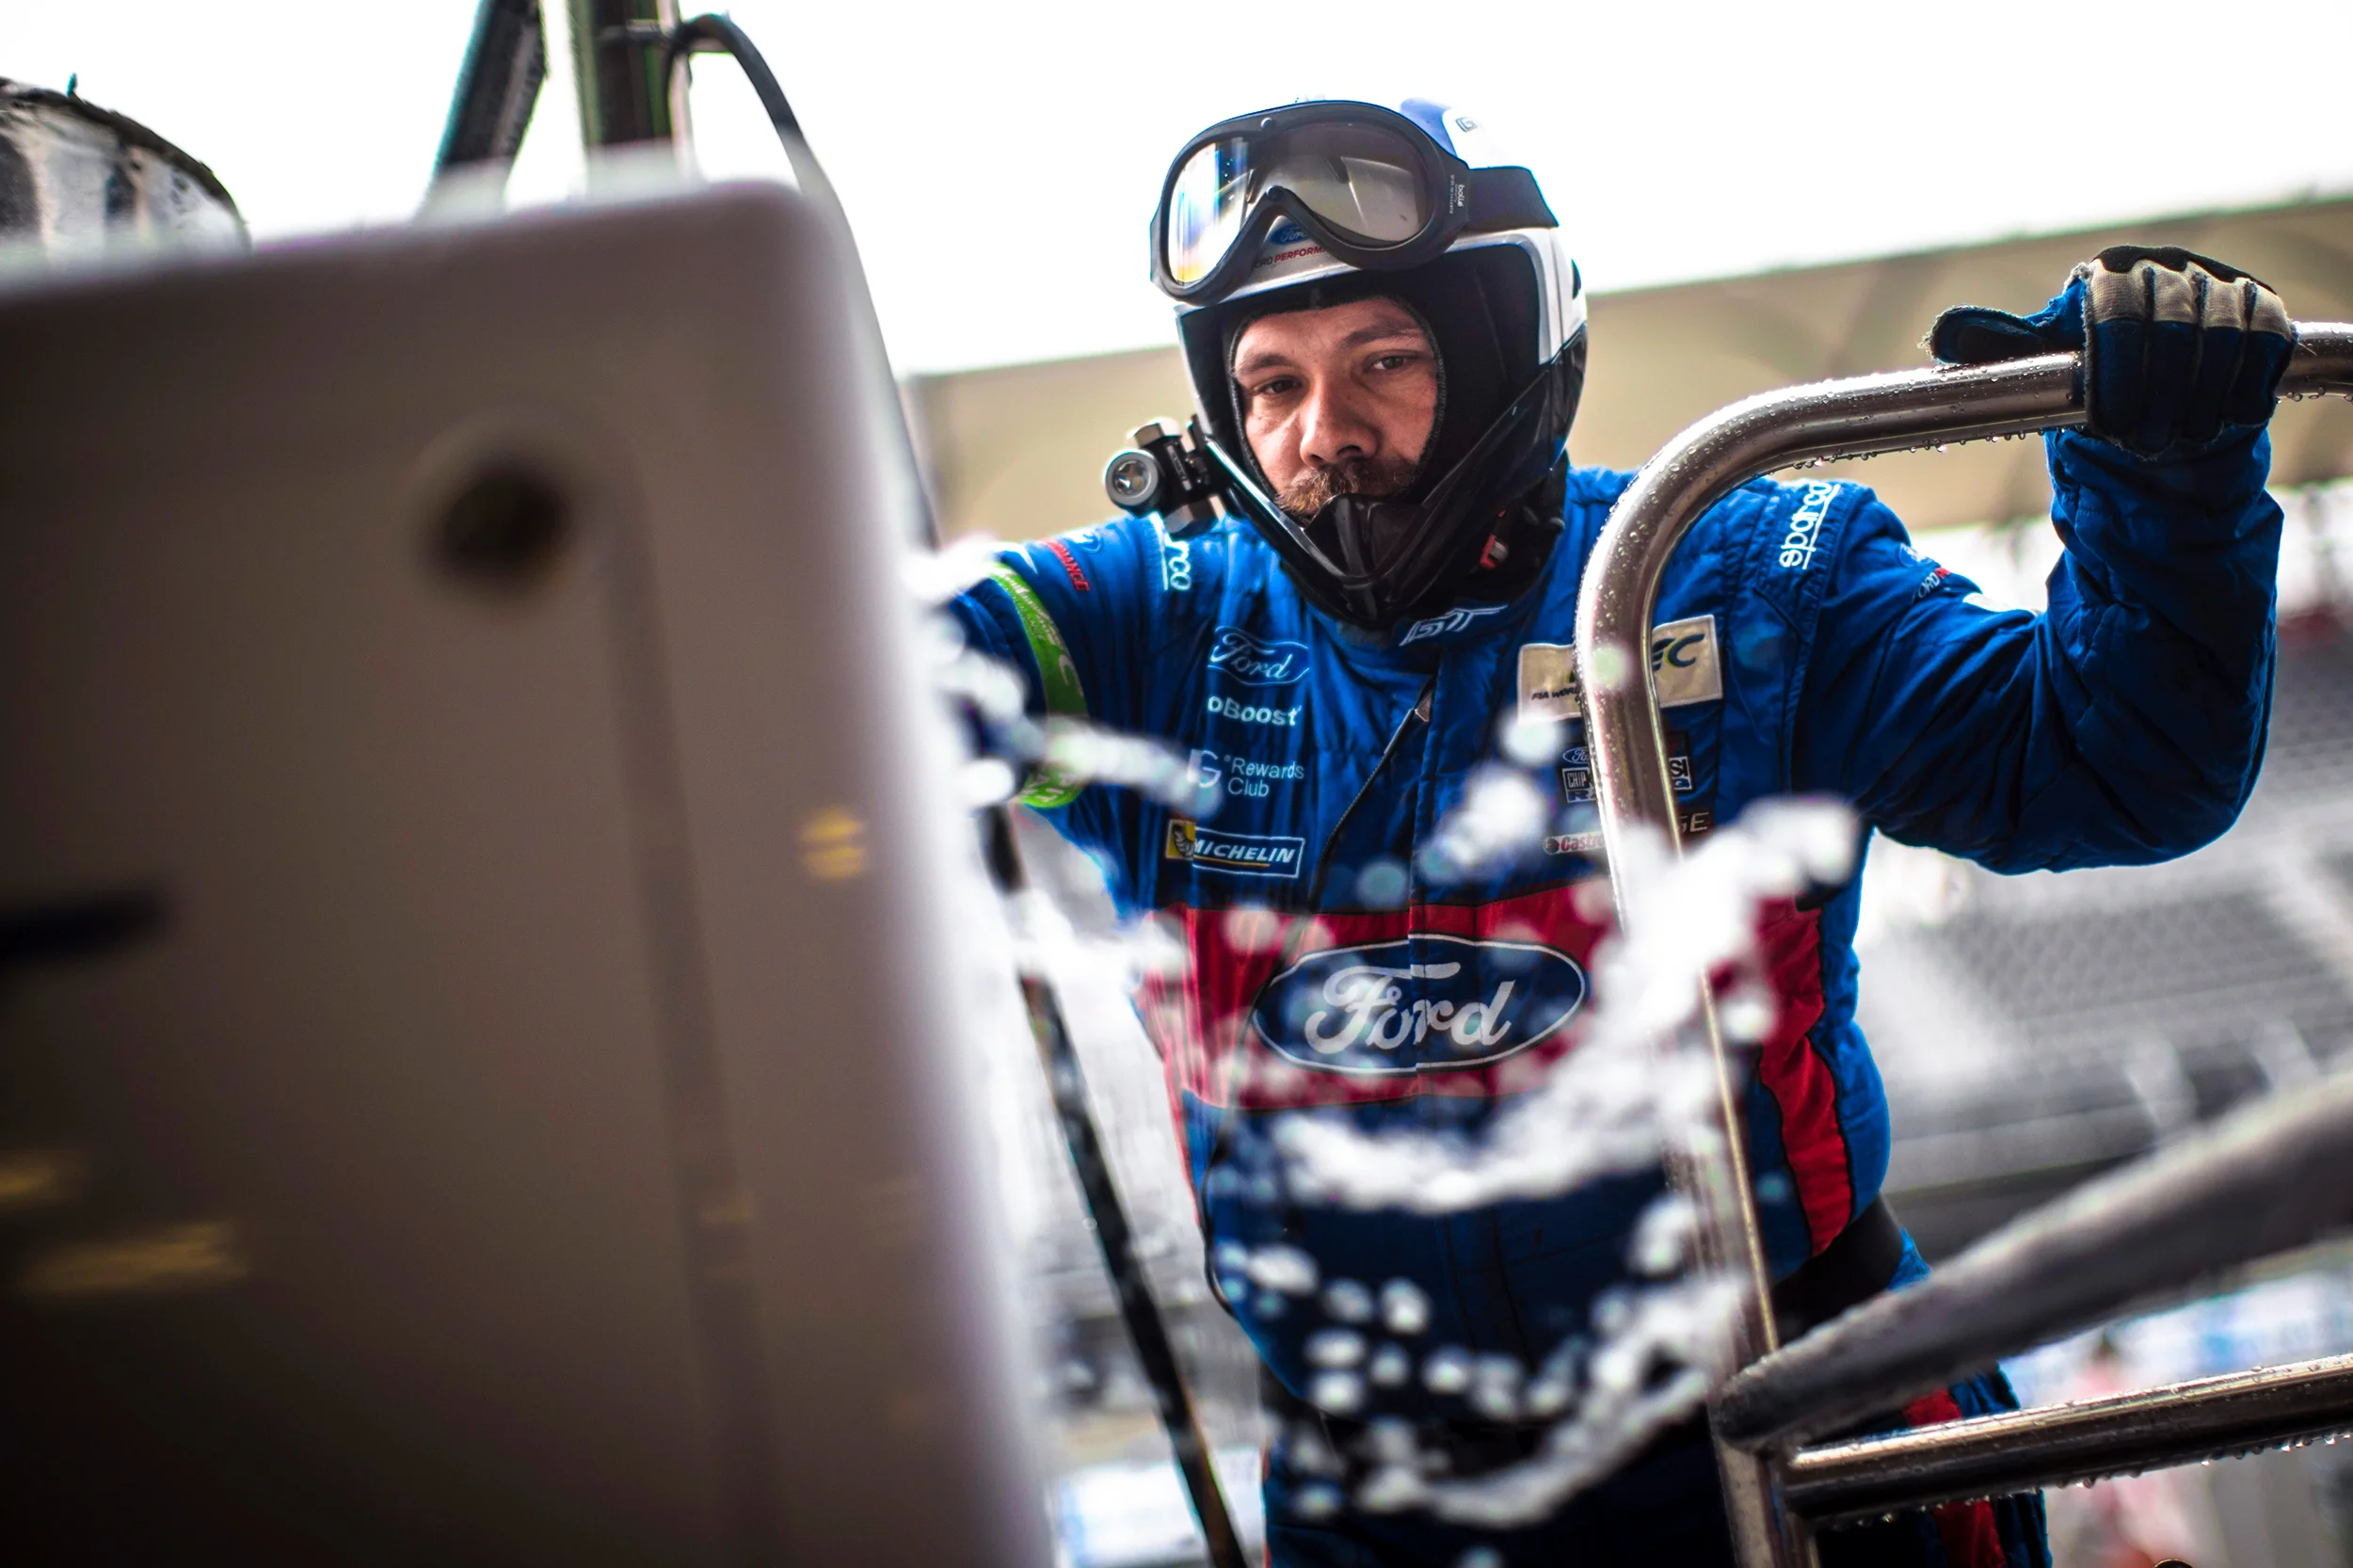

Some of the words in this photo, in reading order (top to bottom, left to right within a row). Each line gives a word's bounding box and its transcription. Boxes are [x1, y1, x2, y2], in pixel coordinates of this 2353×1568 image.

[1273, 246, 1325, 264] PERFORM
[1779, 481, 1833, 568] sparco
[1165, 540, 1192, 591] rco
[1209, 632, 1293, 680] Ford
[1652, 632, 1705, 672] EC
[1531, 691, 1549, 701] FIA
[1552, 686, 1580, 699] WORL
[1231, 756, 1305, 780] Rewards
[1227, 776, 1270, 798] Club
[1566, 772, 1587, 789] CHIP
[1193, 839, 1296, 864] MICHELIN
[1560, 834, 1606, 853] Castro
[1305, 961, 1516, 1055] Ford
